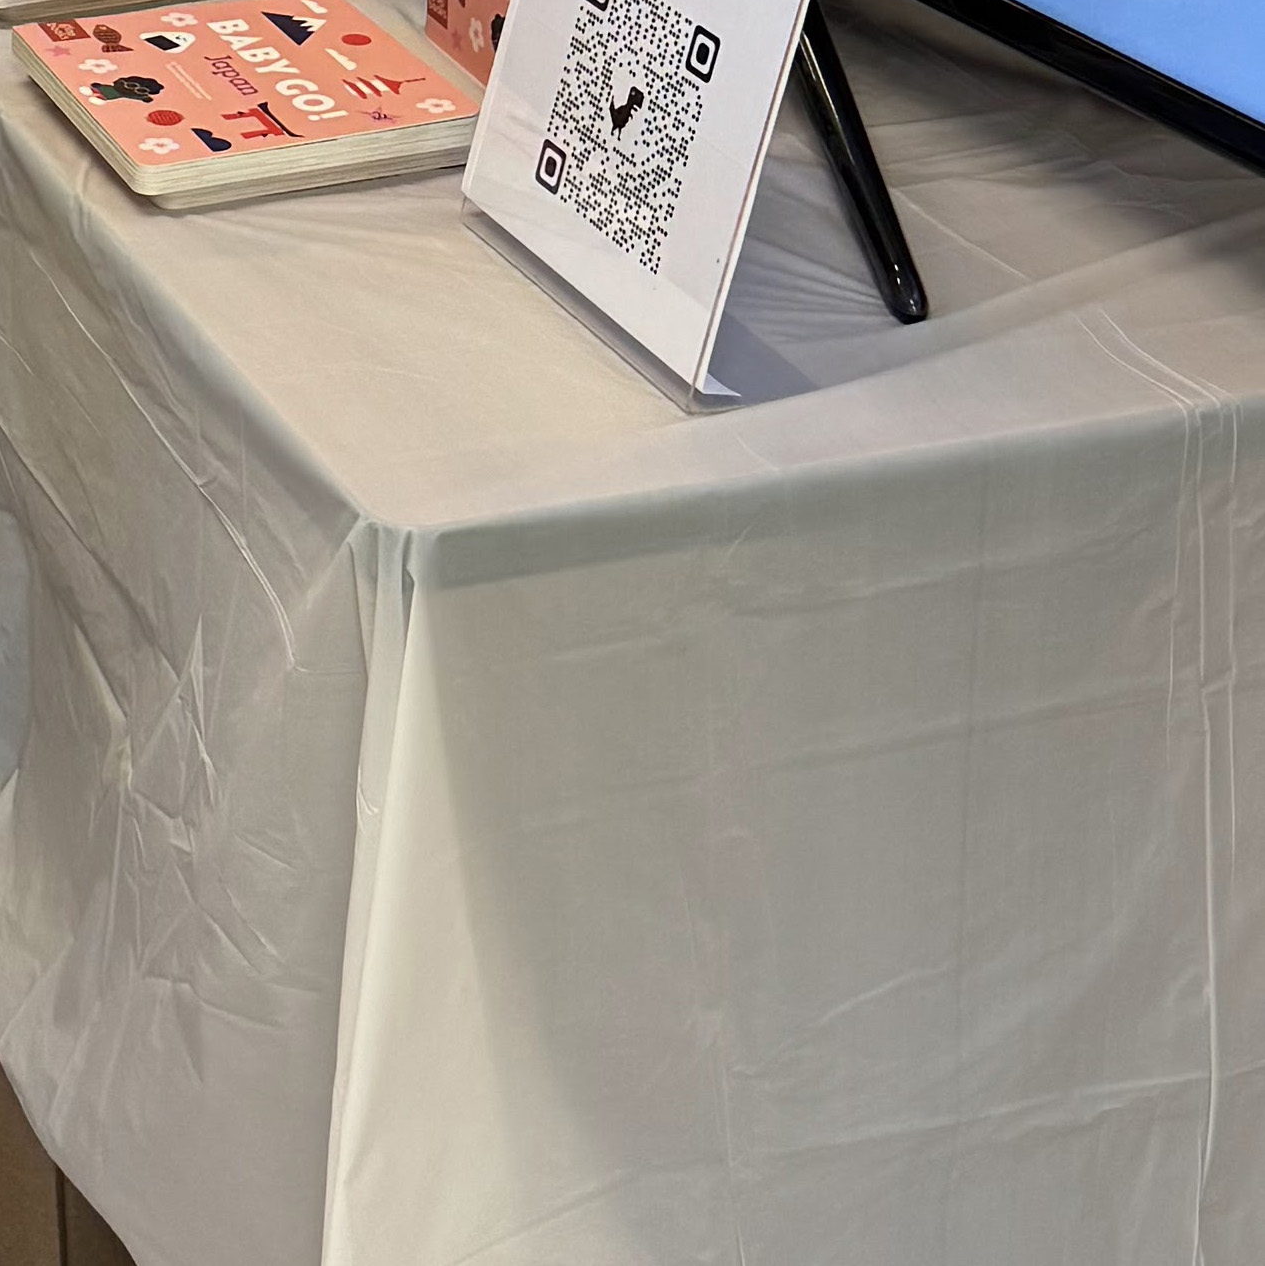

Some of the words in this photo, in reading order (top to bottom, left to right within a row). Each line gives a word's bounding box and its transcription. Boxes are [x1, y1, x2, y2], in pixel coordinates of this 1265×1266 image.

[204, 55, 258, 96] Japan
[206, 19, 300, 74] BABY
[275, 79, 349, 121] GO!
